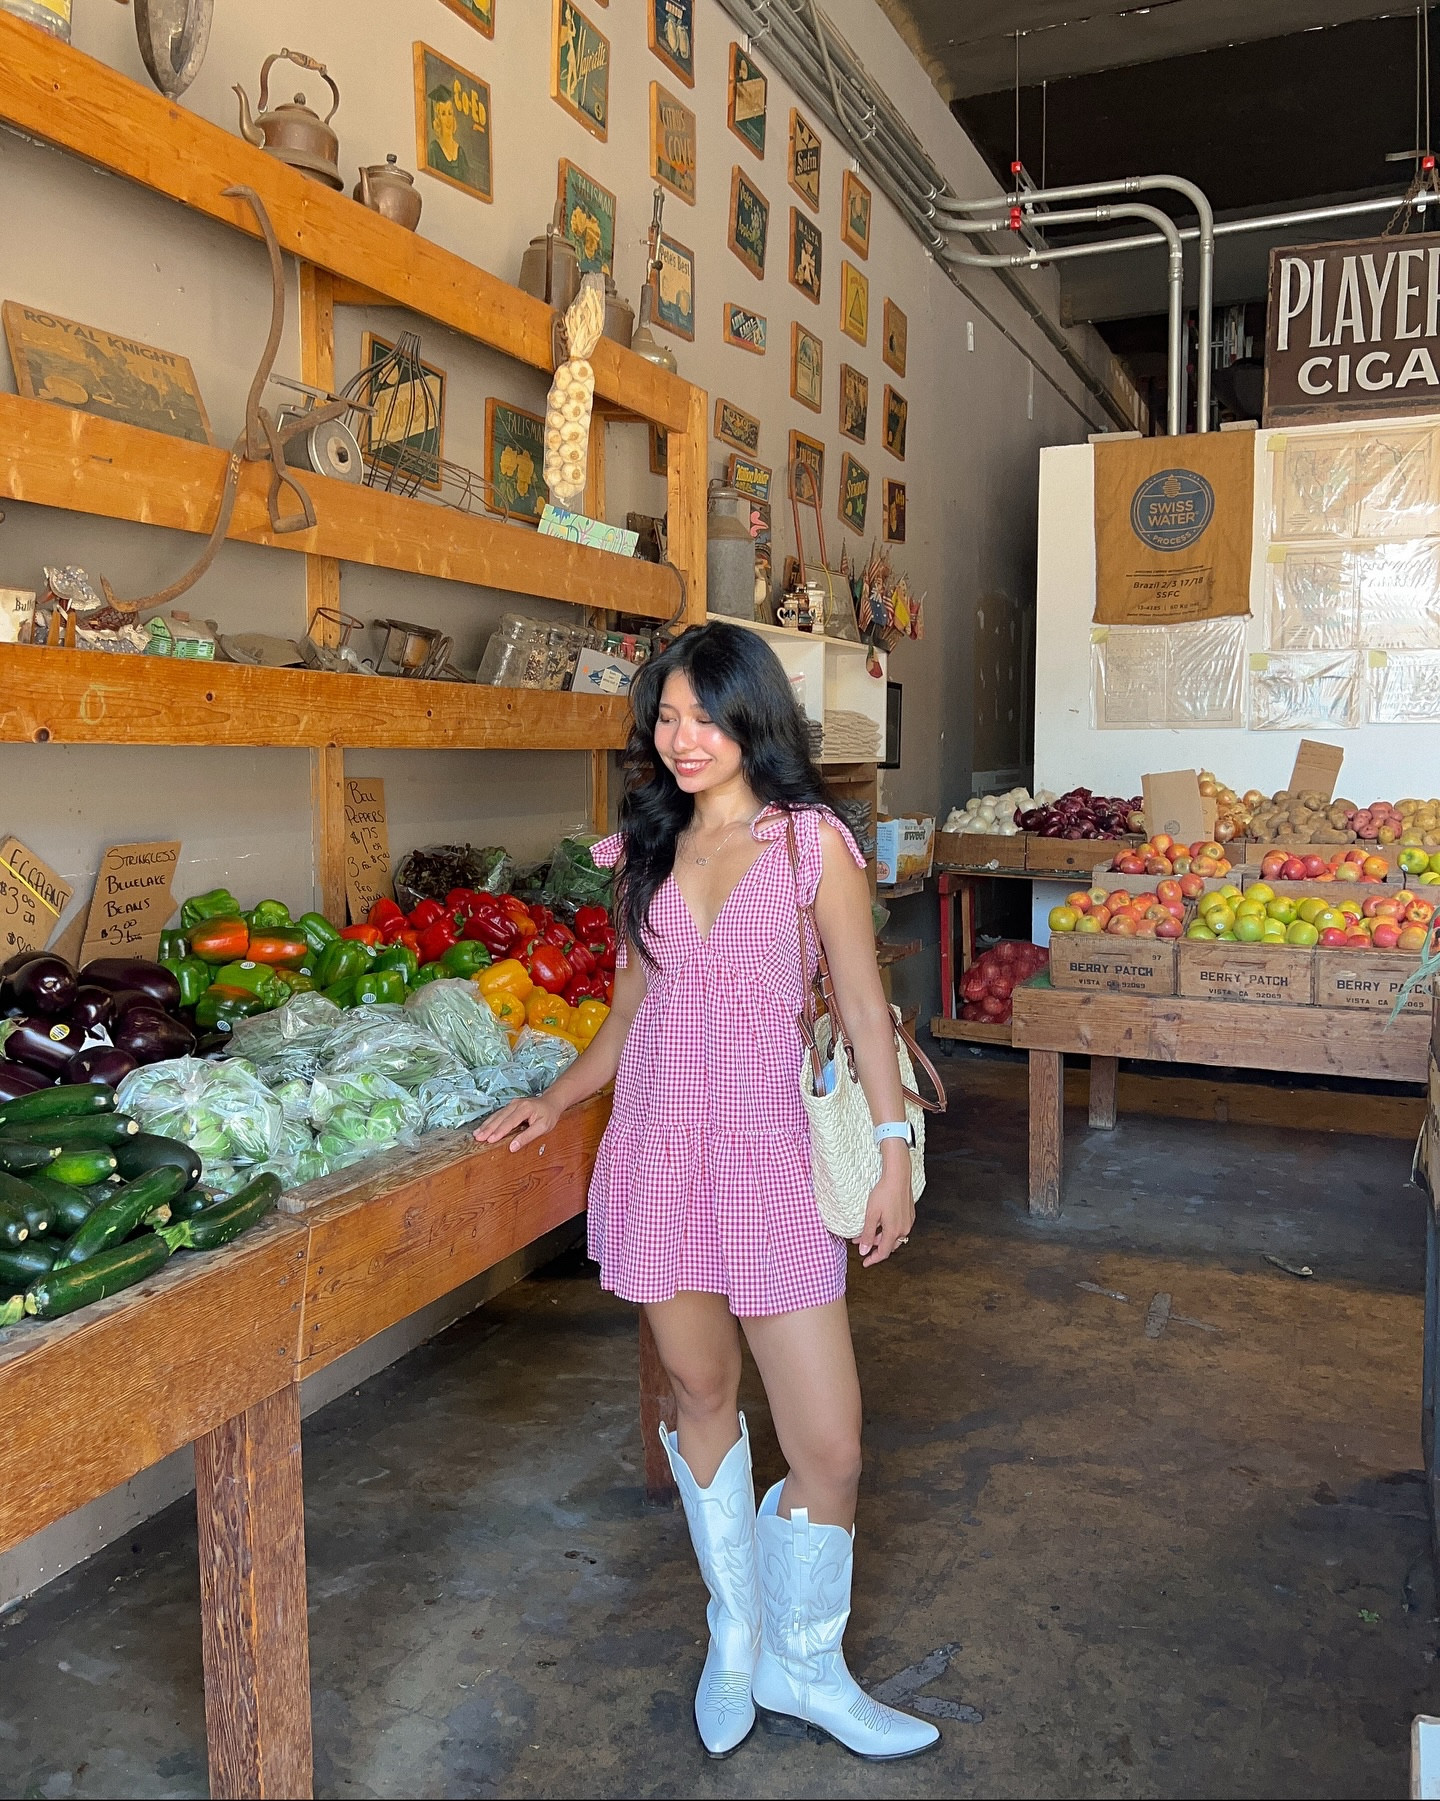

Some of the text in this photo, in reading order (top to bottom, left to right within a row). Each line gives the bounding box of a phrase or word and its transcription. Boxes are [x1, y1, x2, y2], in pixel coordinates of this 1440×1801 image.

[577, 174, 613, 217] TALISMAN
[24, 309, 176, 368] ROYAL KNIGHT
[1149, 499, 1194, 515] SWISS
[1147, 511, 1196, 528] WATER
[1152, 531, 1193, 546] PROCESS
[1133, 580, 1160, 590] Brazil
[1160, 579, 1178, 590] 2/3
[1155, 590, 1181, 599] SSFC
[344, 804, 385, 825] PEPPERS
[106, 848, 177, 871] STRINGLESS
[105, 874, 166, 895] BLUELAKE
[103, 897, 151, 918] BEANS
[1069, 961, 1154, 978] BERRY PATCH
[1078, 978, 1101, 987] VISTA
[1121, 981, 1146, 990] 92069
[1200, 970, 1289, 988] BERRY PATCH
[1336, 979, 1381, 993] BERRY
[1208, 987, 1282, 1000] VISTA CA 92069
[1345, 997, 1371, 1006] VISTA
[1377, 999, 1389, 1007] CA
